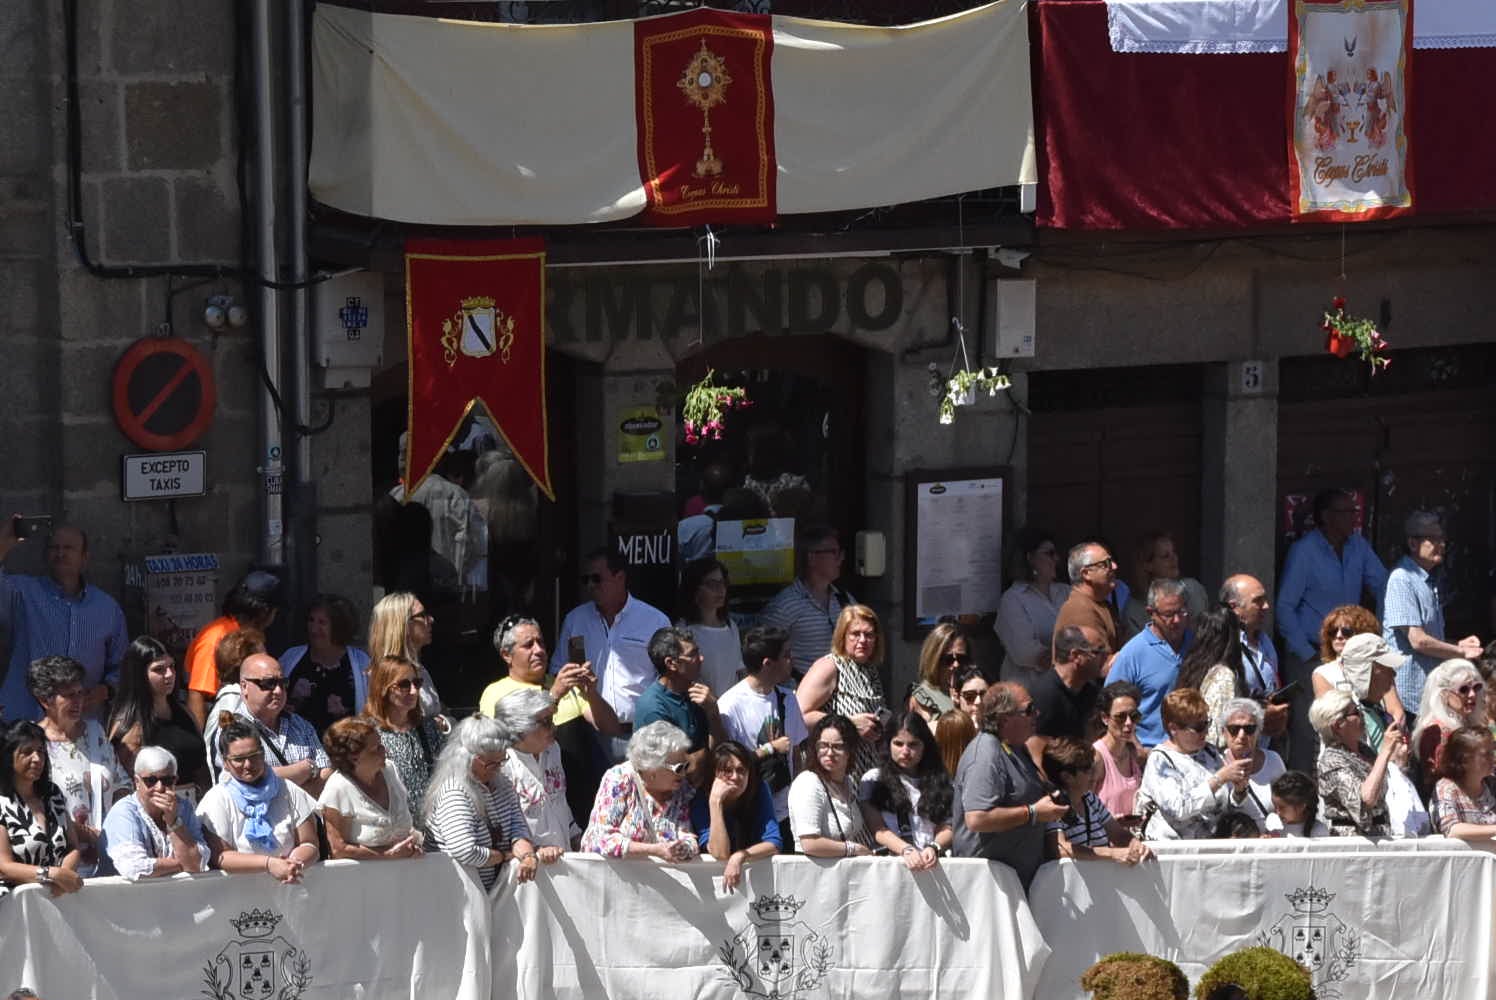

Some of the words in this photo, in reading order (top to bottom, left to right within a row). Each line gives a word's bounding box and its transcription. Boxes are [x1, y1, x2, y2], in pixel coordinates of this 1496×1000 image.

[1245, 366, 1259, 388] 5
[141, 459, 190, 475] EXCEPTO
[150, 478, 181, 491] TAXIS
[618, 528, 671, 565] MENÚ
